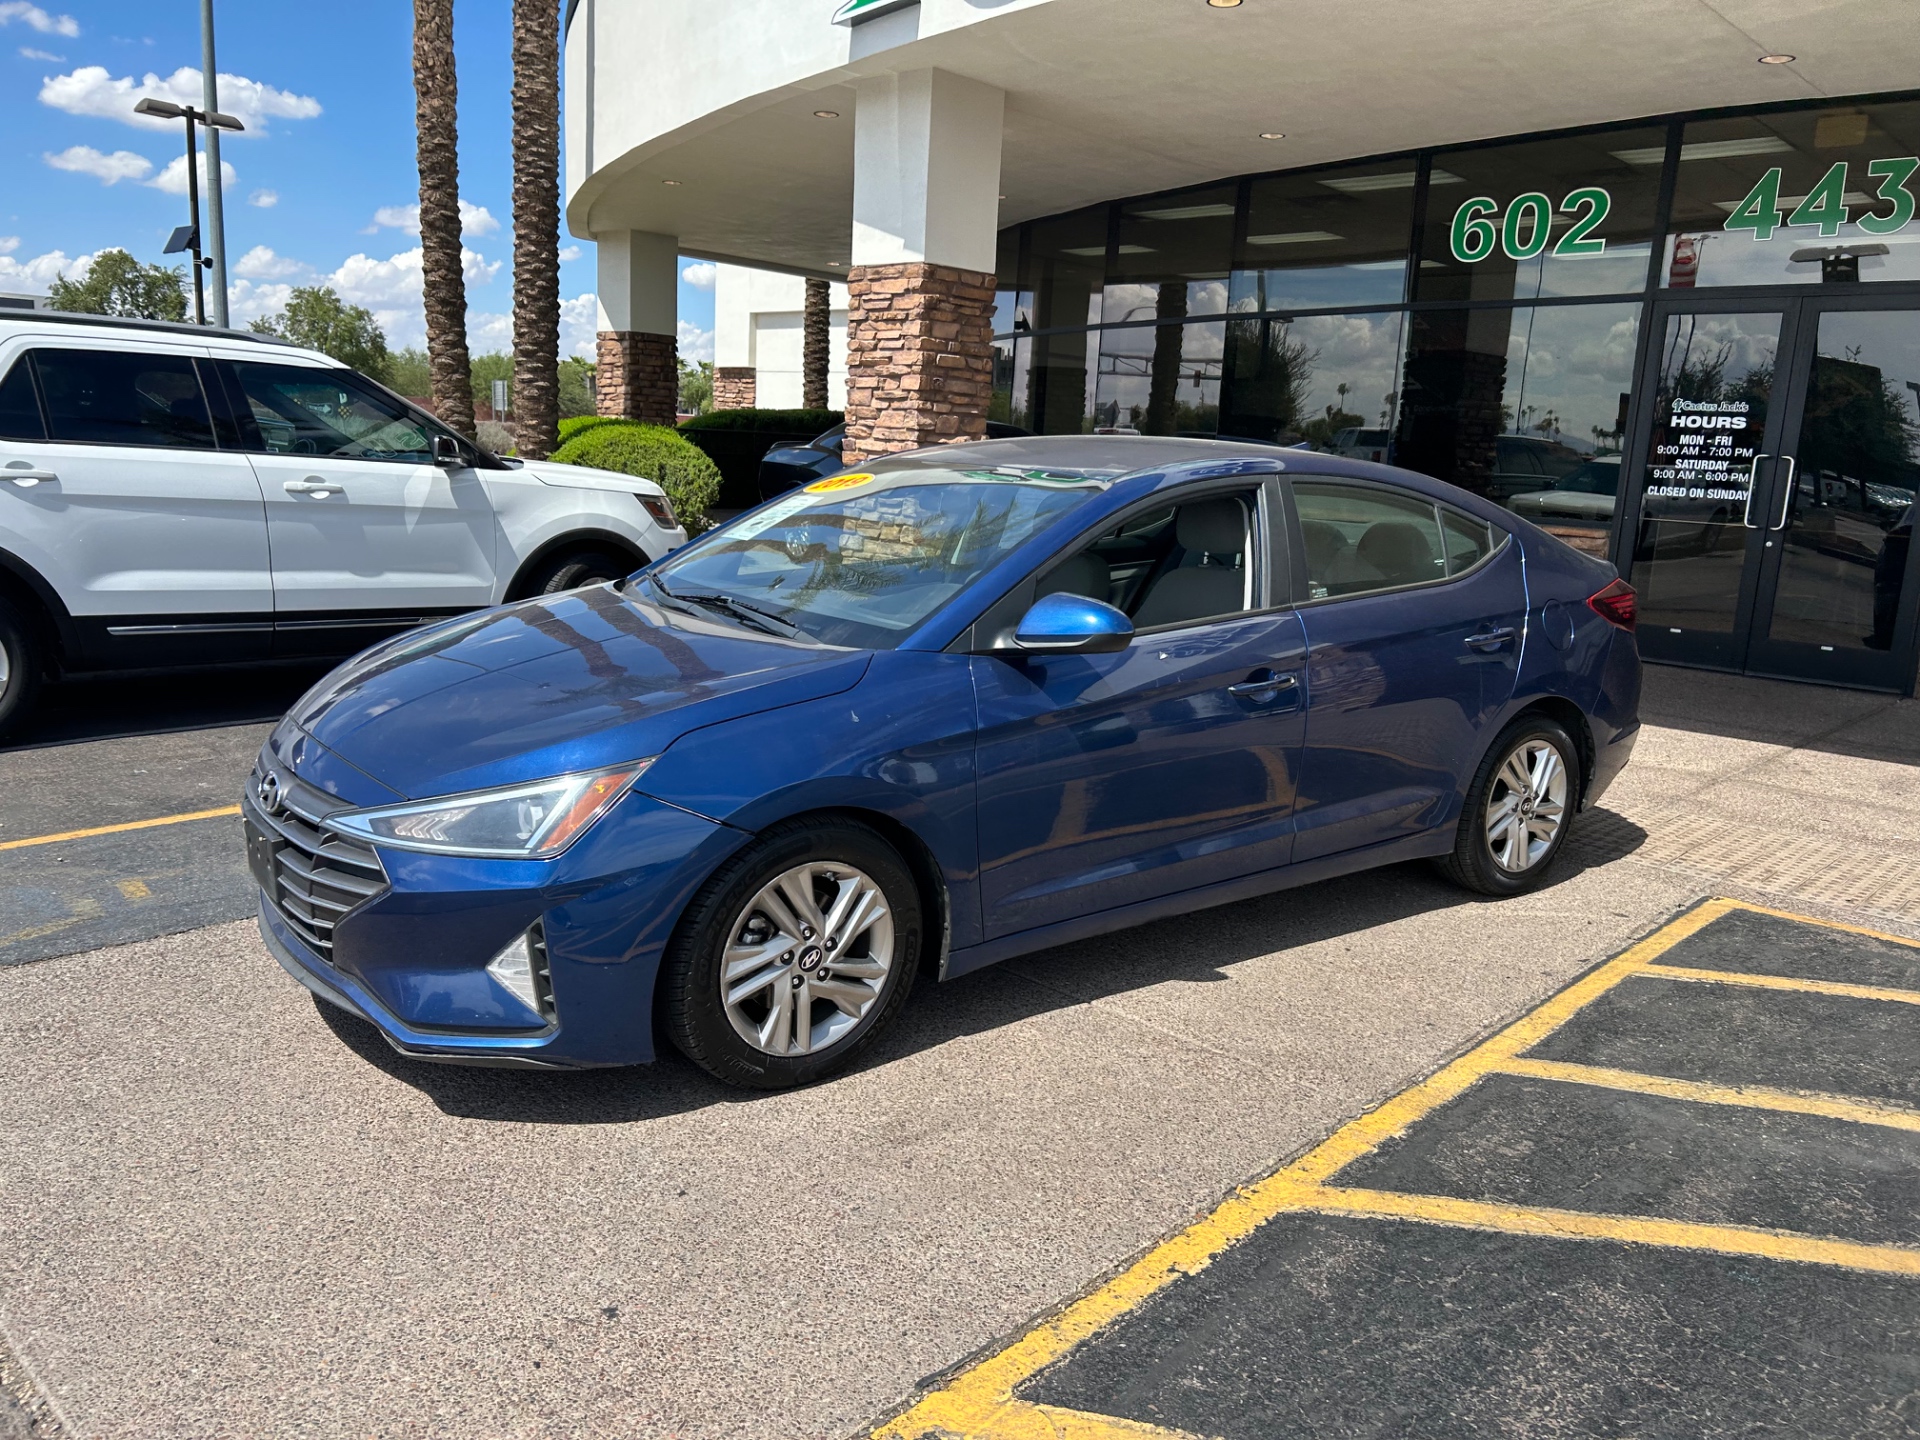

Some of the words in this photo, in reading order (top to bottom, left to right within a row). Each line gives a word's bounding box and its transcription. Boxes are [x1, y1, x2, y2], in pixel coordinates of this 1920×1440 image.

[1450, 186, 1611, 263] 602
[1723, 156, 1920, 241] 443
[1682, 400, 1717, 412] Cactus
[1718, 401, 1750, 413] Jack's
[1670, 415, 1747, 429] HOURS
[1679, 434, 1705, 446] MON
[1714, 435, 1733, 446] FRI
[1657, 445, 1679, 455] 9:00
[1680, 446, 1699, 456] AM
[1709, 447, 1732, 457] 7:00
[1734, 447, 1753, 457] PM
[1674, 458, 1729, 471] SATURDAY
[1653, 469, 1675, 479] 9:00
[1677, 470, 1695, 480] AM
[1705, 471, 1728, 481] 6:00
[1730, 472, 1749, 482] PM
[1647, 485, 1686, 497] CLOSED
[1689, 487, 1705, 498] ON
[1706, 488, 1750, 501] SUNDAY
